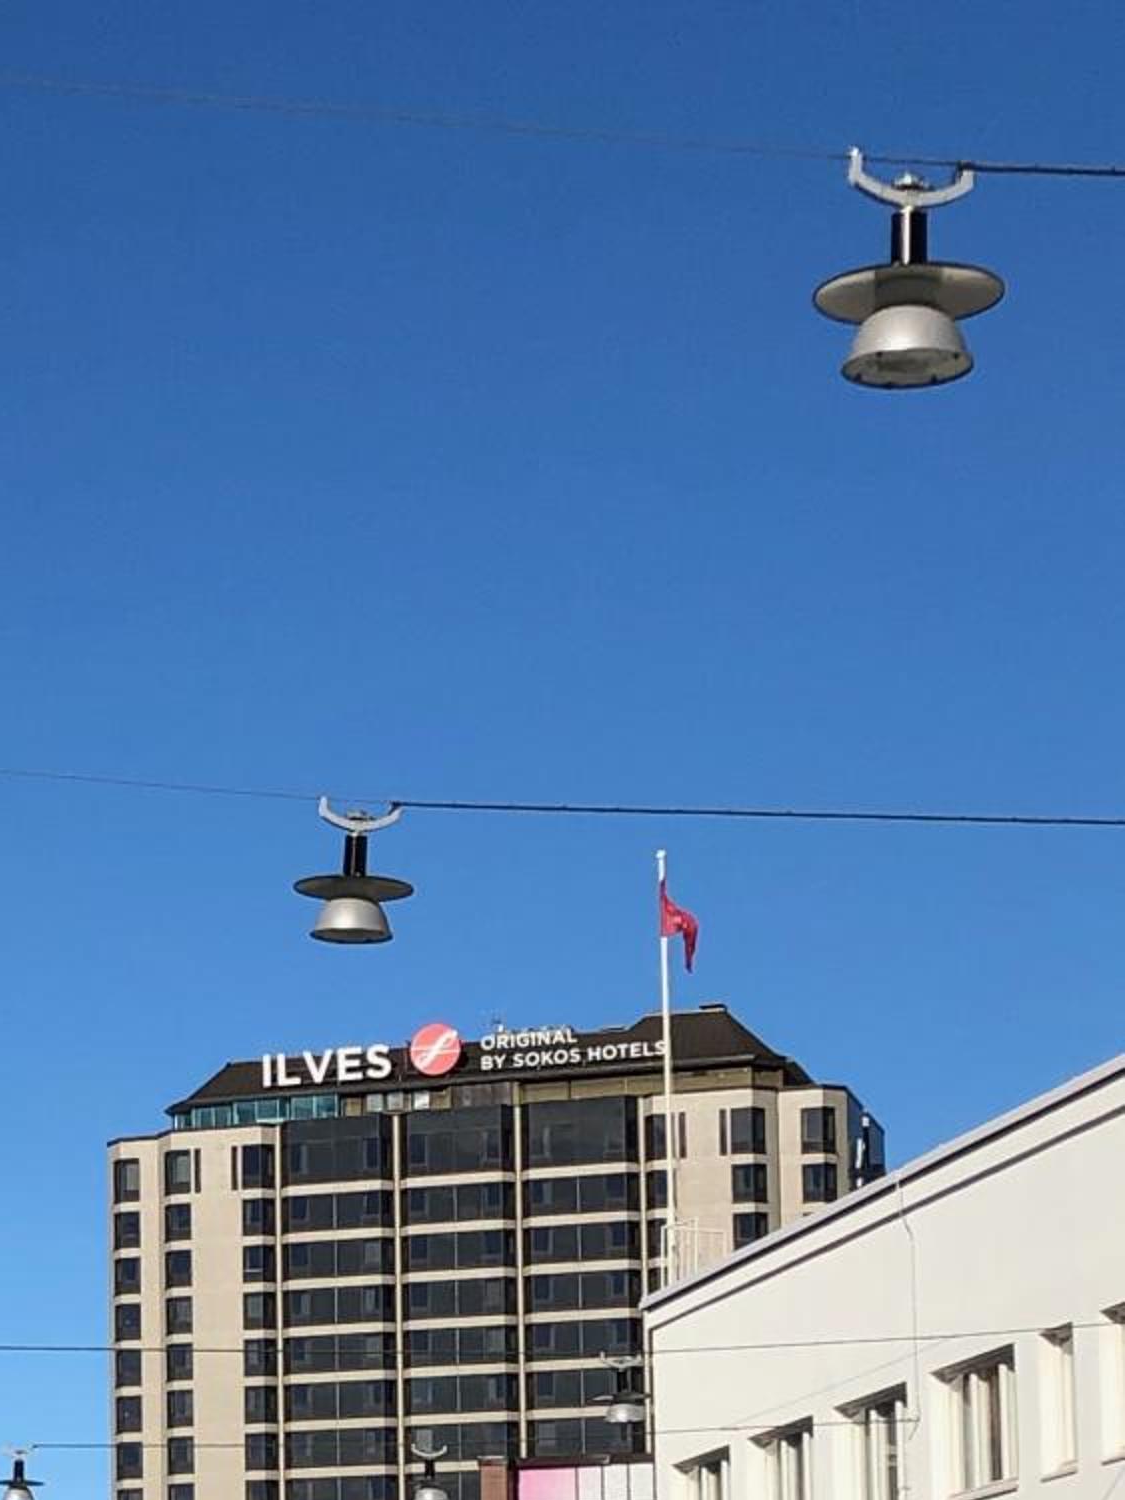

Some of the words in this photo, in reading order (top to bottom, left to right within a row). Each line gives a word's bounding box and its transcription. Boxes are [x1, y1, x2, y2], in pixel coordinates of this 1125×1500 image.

[480, 1028, 578, 1050] ORIGINAL
[262, 1044, 392, 1088] ILVES
[480, 1054, 506, 1071] BY
[512, 1049, 581, 1068] SOKOS
[587, 1040, 666, 1062] HOTELS
